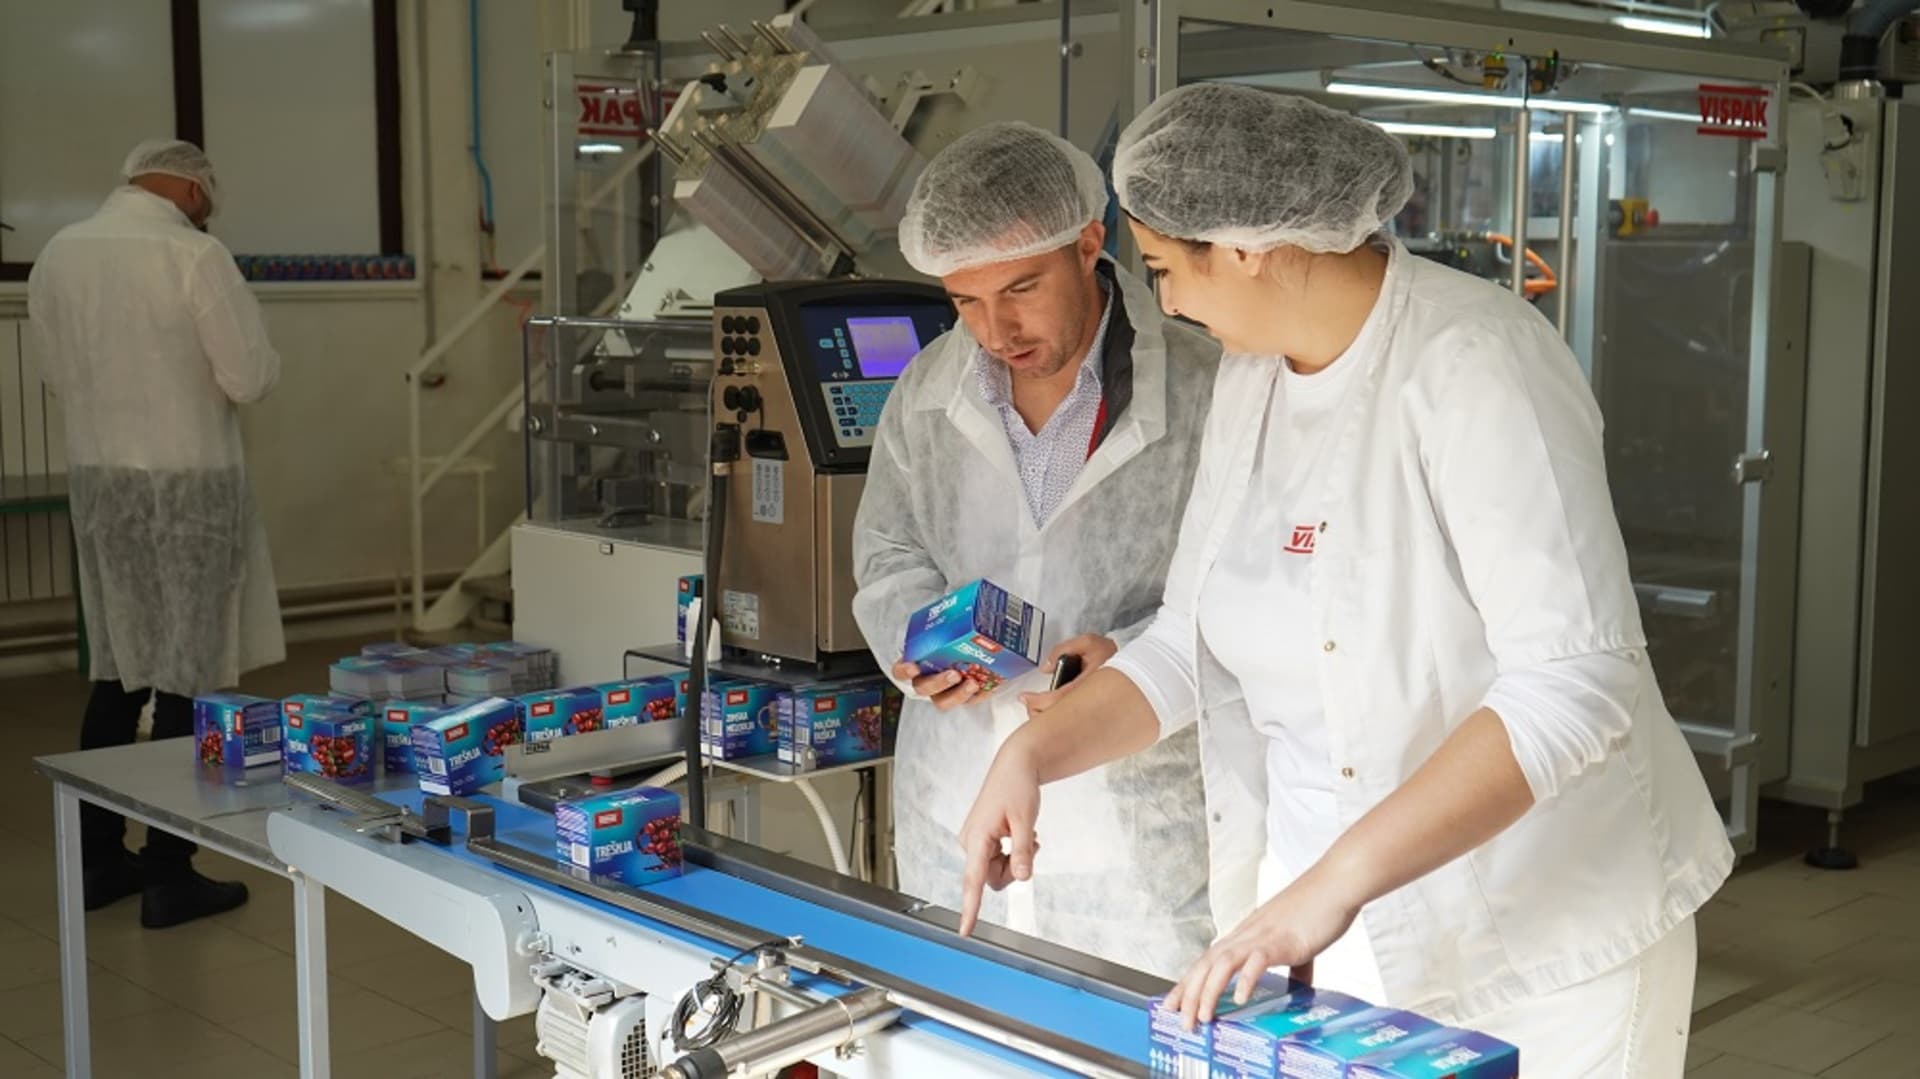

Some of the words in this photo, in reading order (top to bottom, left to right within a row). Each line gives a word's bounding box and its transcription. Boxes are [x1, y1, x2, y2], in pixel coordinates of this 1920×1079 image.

[1699, 95, 1767, 127] VISPAK
[449, 747, 481, 768] TREŠNJA
[594, 840, 633, 860] TREŠNJA
